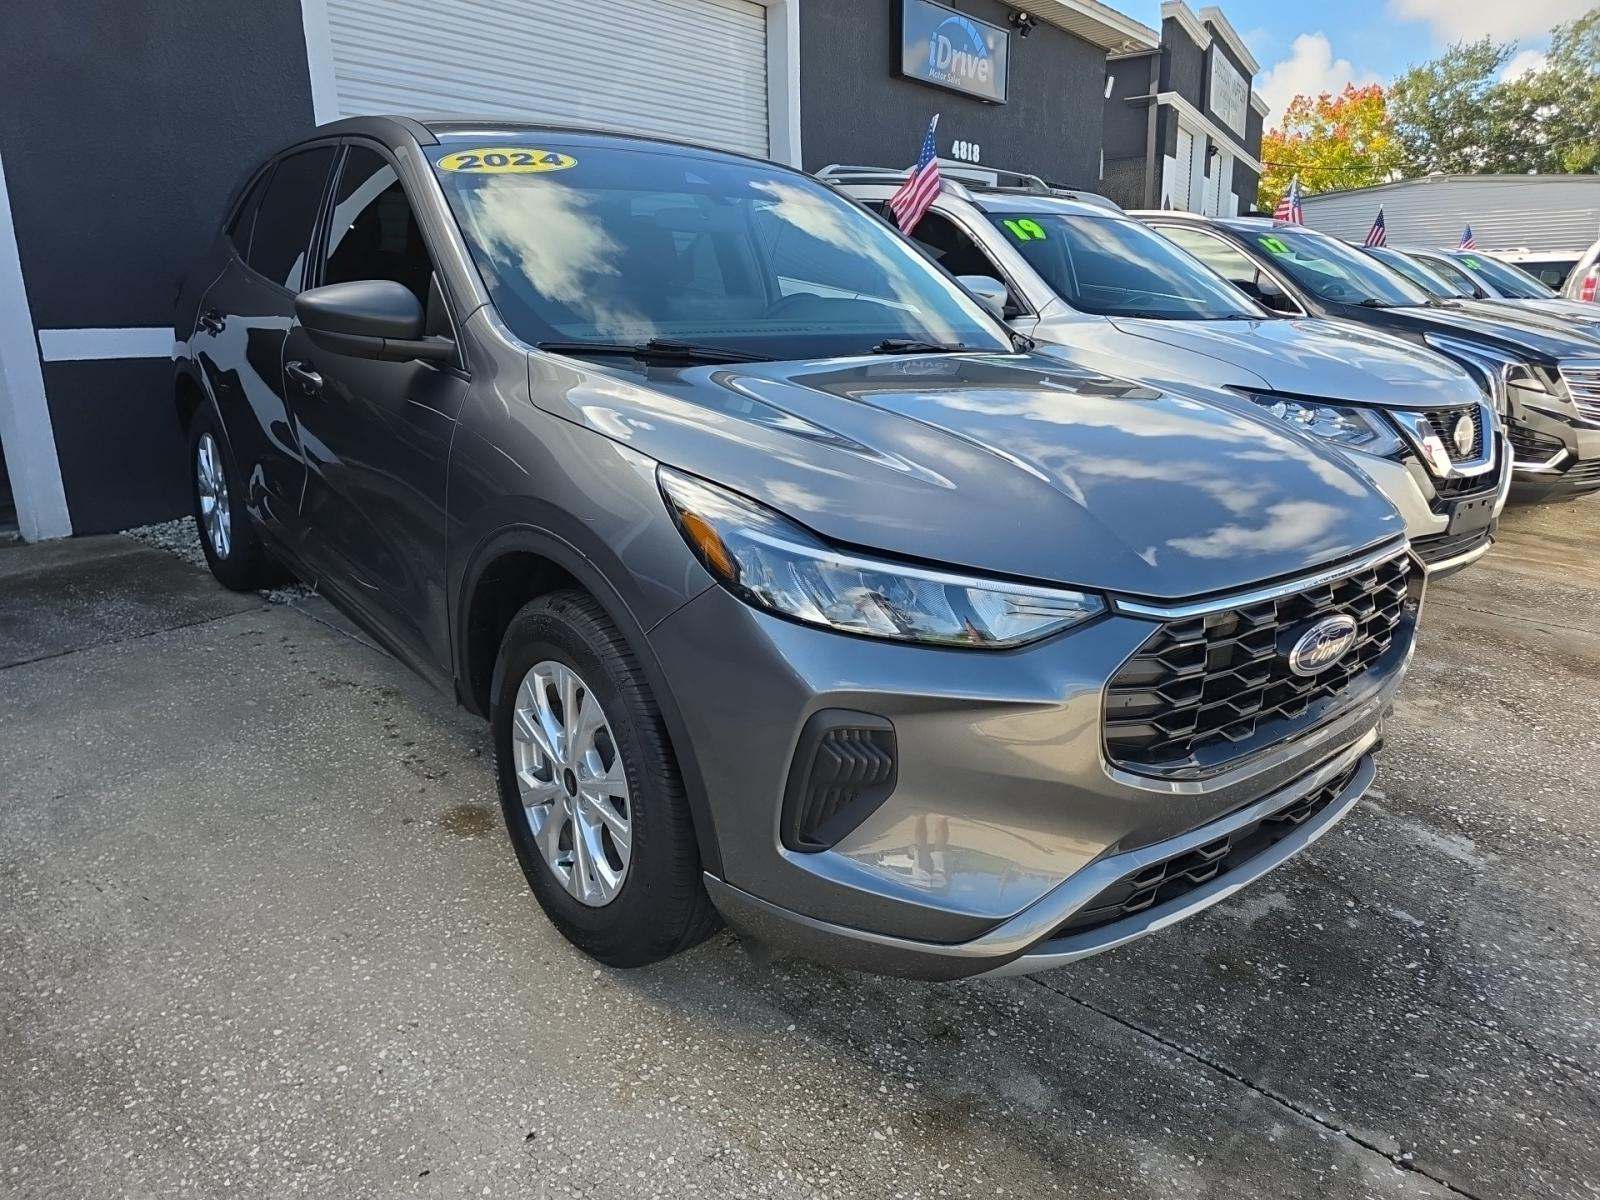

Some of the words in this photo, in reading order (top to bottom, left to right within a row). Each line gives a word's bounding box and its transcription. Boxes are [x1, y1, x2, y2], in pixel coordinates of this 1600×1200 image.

[929, 31, 988, 81] iDrive
[928, 67, 947, 80] Motor
[456, 153, 564, 169] 2024
[952, 140, 980, 162] 4818
[1003, 219, 1047, 240] 19
[1310, 632, 1350, 666] Ford
